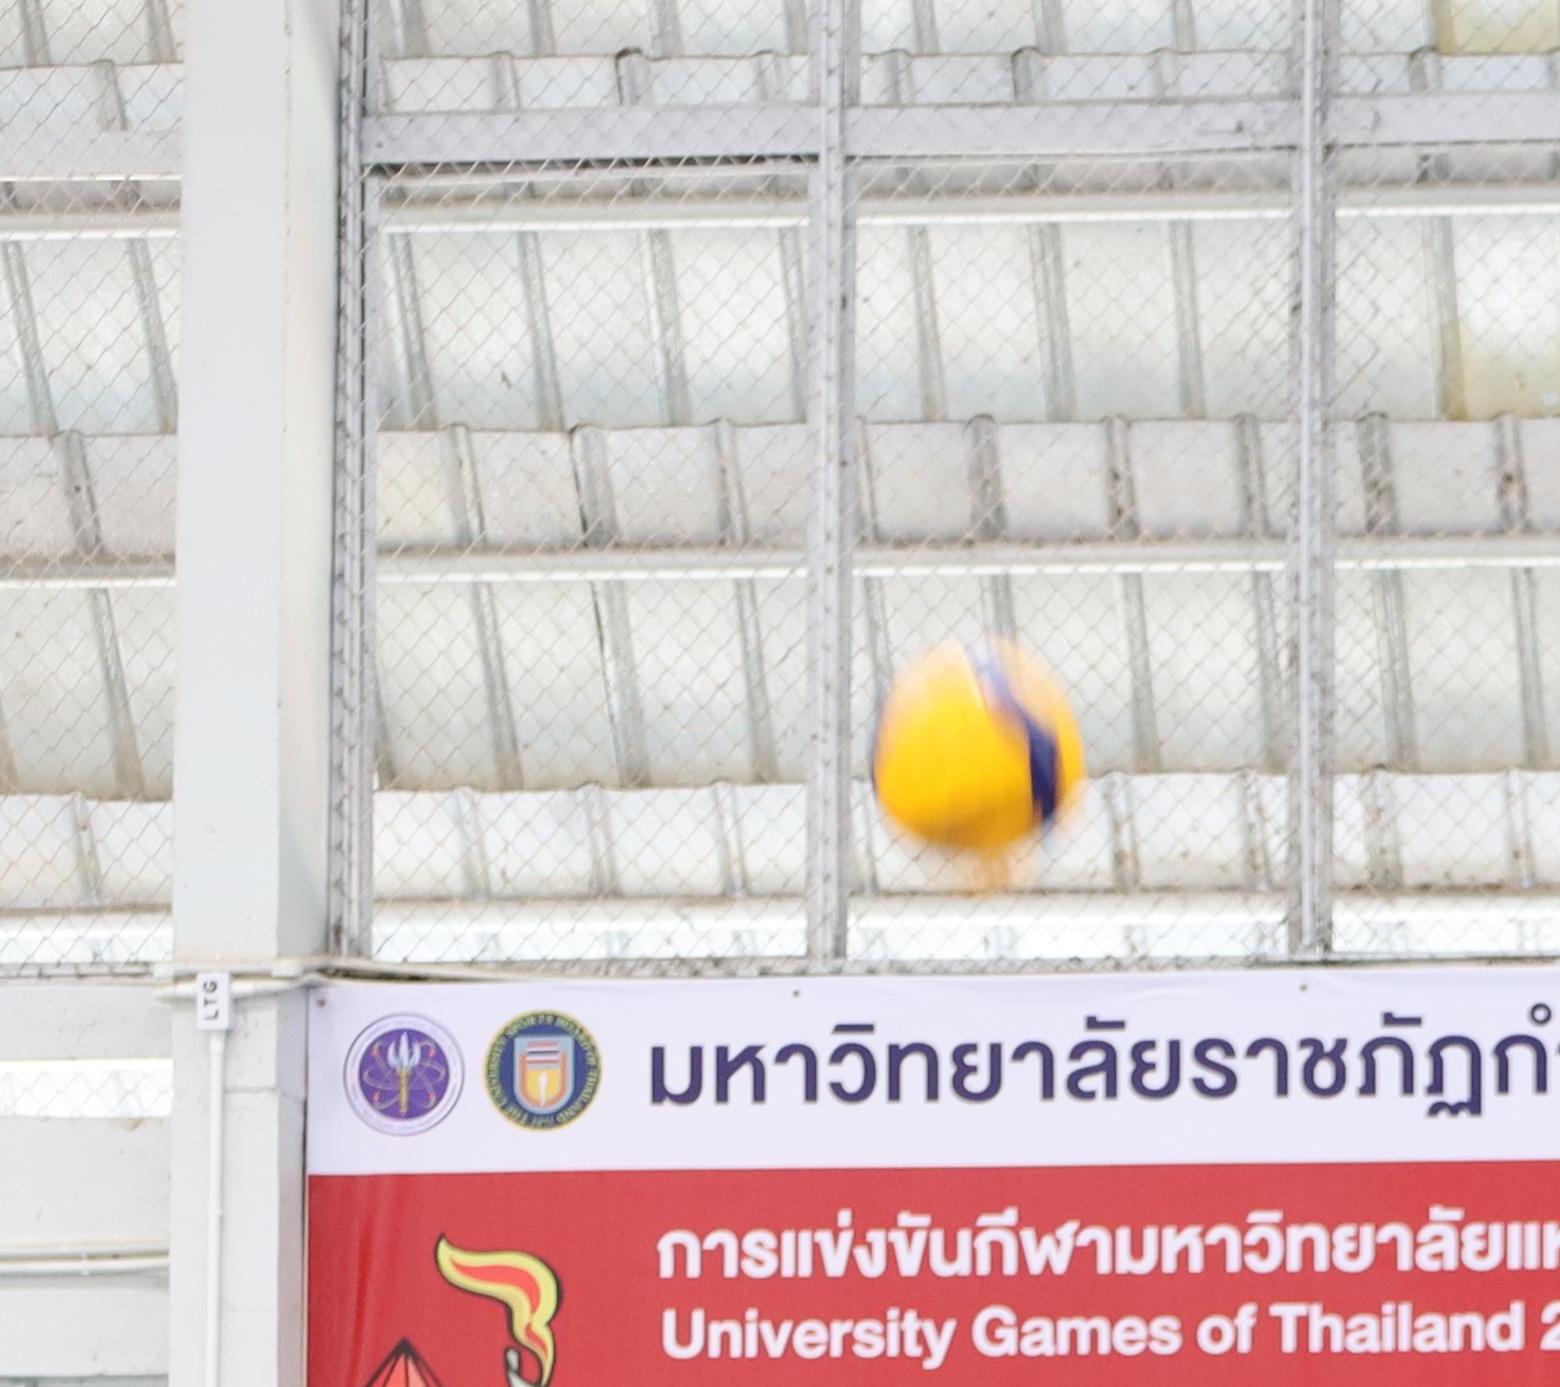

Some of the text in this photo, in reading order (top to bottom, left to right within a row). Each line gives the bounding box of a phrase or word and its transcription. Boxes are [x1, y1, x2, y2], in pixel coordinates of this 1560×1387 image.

[662, 1308, 958, 1370] University
[972, 1305, 1183, 1357] Games
[1197, 1303, 1258, 1355] of
[1269, 1301, 1525, 1353] Thailand
